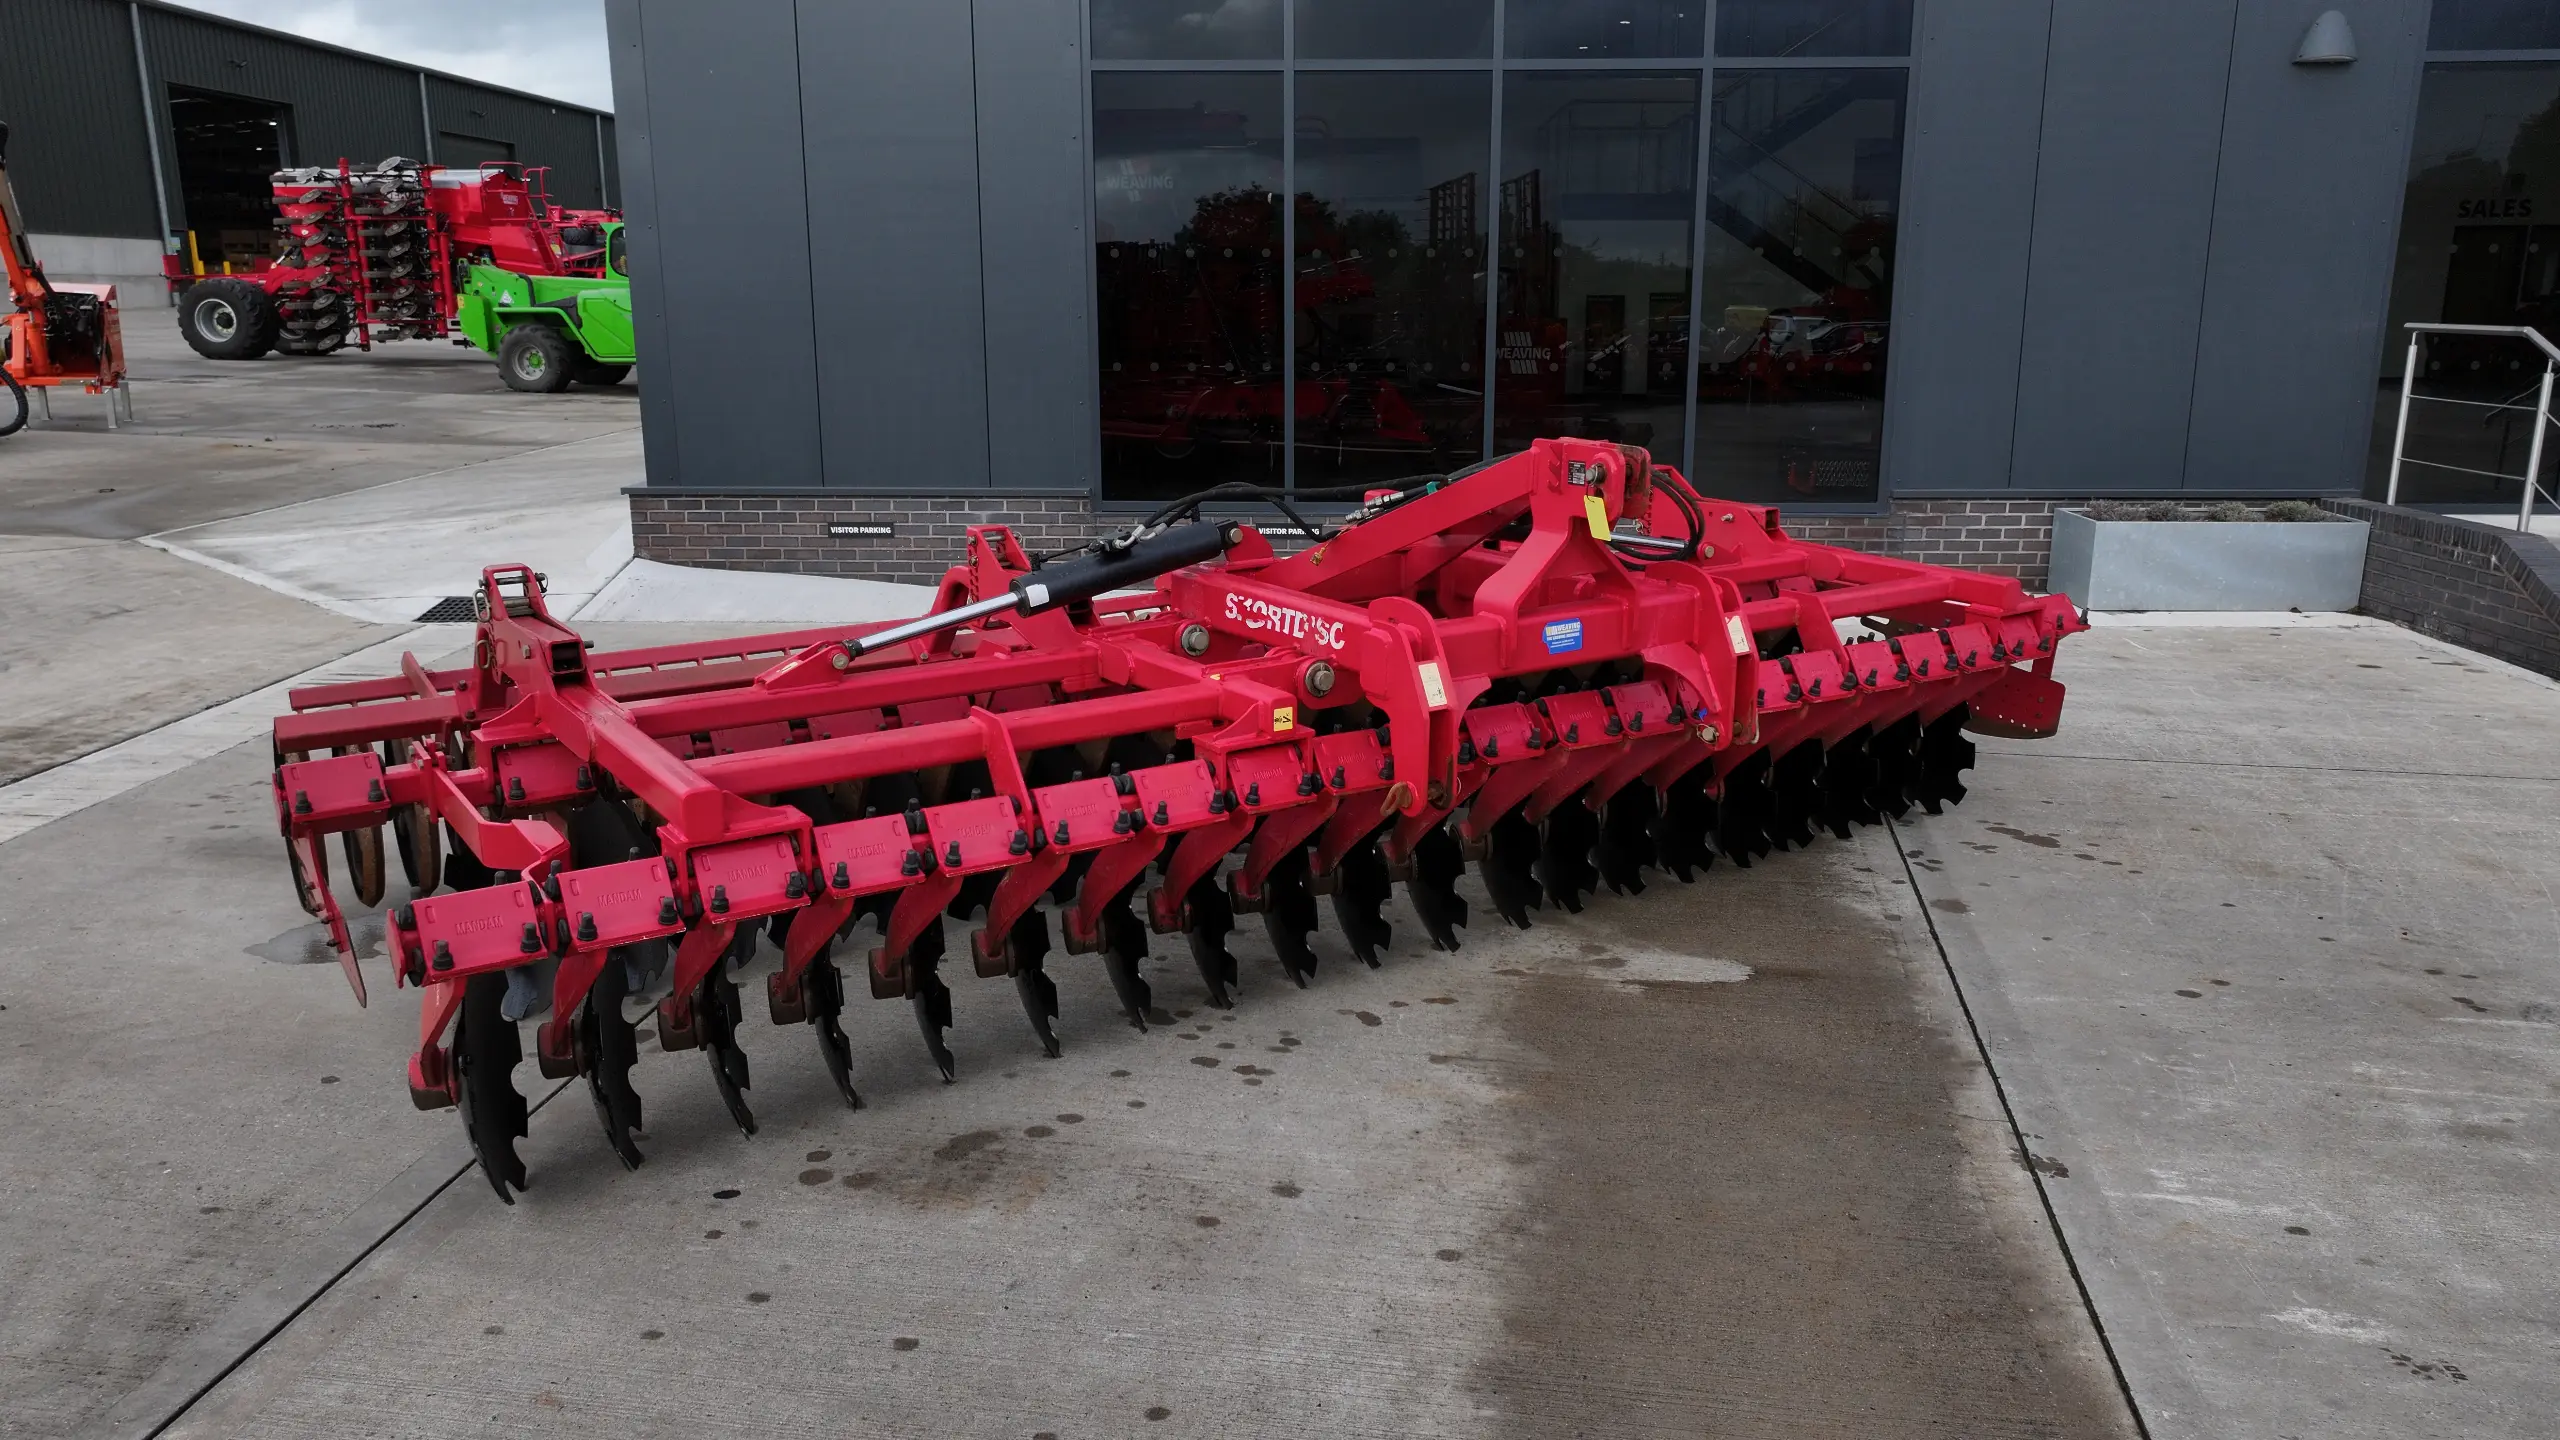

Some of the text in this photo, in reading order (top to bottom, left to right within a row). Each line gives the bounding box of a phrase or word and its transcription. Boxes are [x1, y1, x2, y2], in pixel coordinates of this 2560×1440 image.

[1106, 176, 1174, 189] WEAVING
[2457, 199, 2532, 218] SALES
[830, 526, 892, 534] VISITOR PARKING
[1258, 527, 1288, 535] VISITOR
[847, 841, 887, 858] MANDAM
[728, 864, 769, 882] MANDAM
[597, 888, 643, 907] MANDAM
[455, 915, 504, 936] MANDAM
